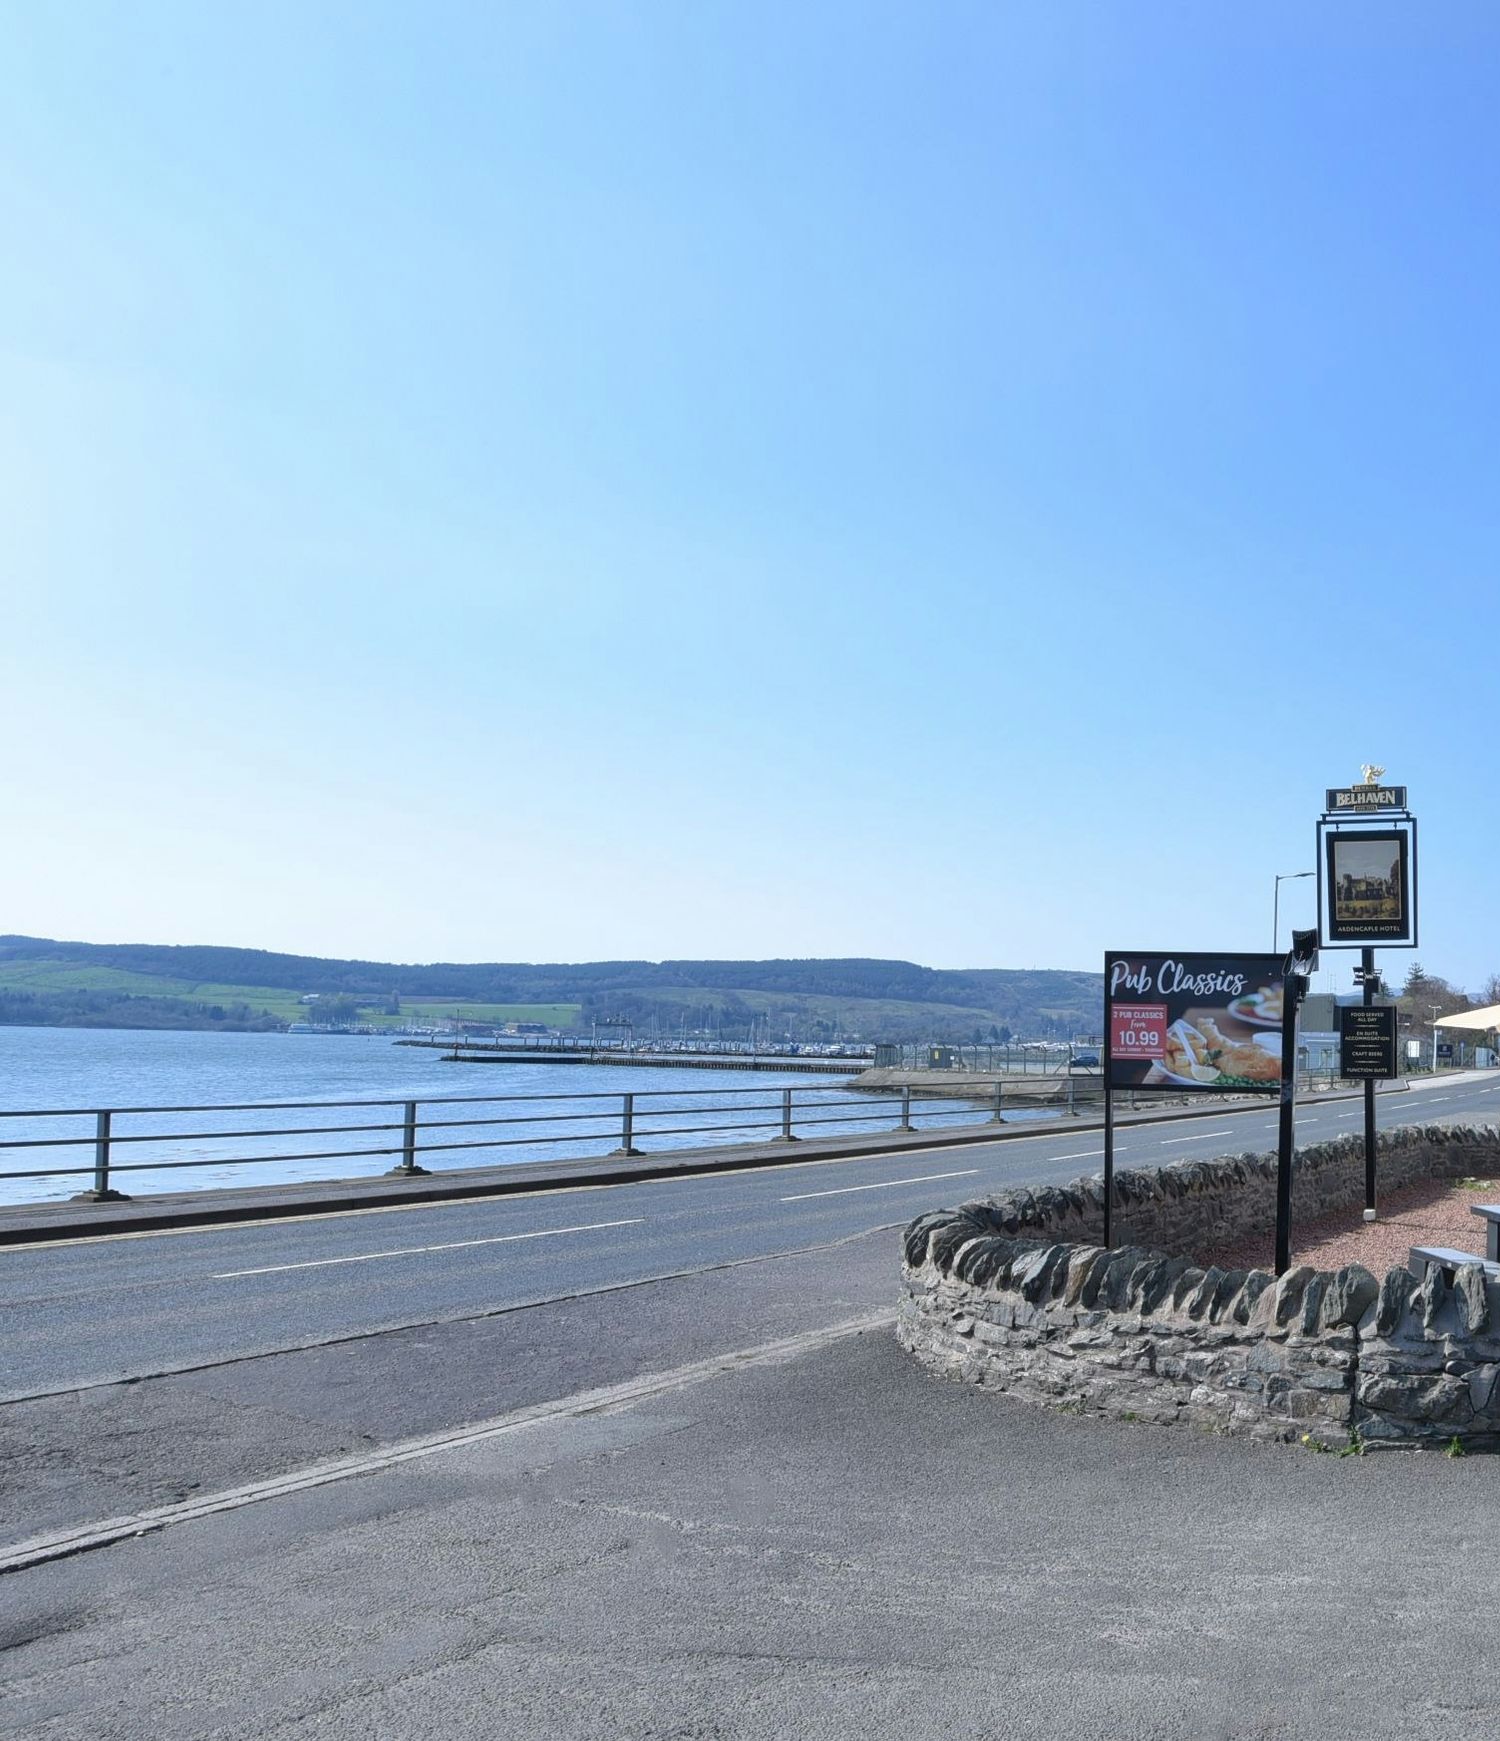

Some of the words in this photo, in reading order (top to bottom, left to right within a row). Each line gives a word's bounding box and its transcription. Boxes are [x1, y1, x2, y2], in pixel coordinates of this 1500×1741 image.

[1336, 790, 1396, 807] BELHAVEN
[1111, 960, 1152, 996] Pub
[1157, 960, 1248, 995] Classics
[1133, 1011, 1164, 1019] CLASSICS
[1119, 1031, 1159, 1046] 10.99
